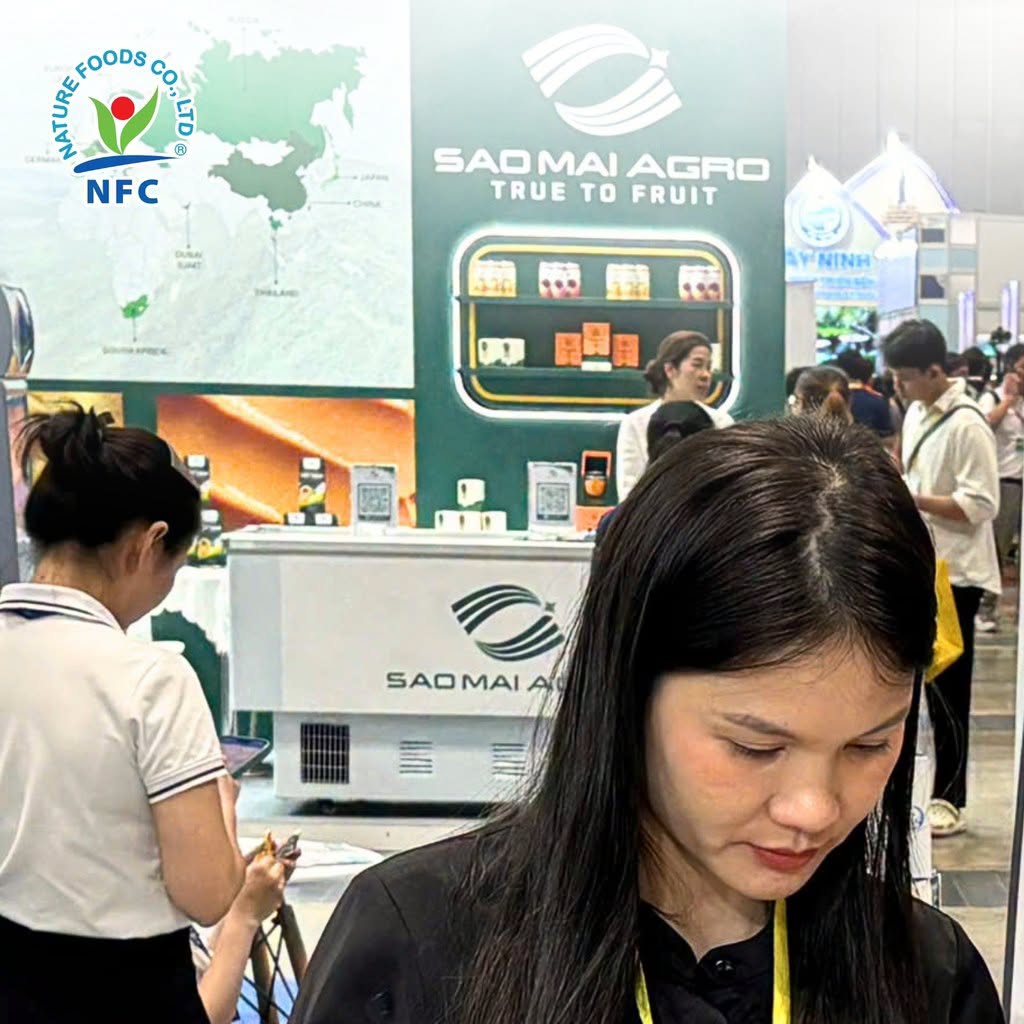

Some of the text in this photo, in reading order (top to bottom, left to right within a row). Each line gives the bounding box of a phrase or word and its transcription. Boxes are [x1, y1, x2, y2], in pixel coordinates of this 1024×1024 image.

[434, 147, 770, 182] SAO MAI AGRO
[490, 180, 719, 205] TRUE TO FRUIT
[818, 251, 871, 268] NINH
[386, 672, 456, 690] SAO
[462, 674, 519, 691] MAI
